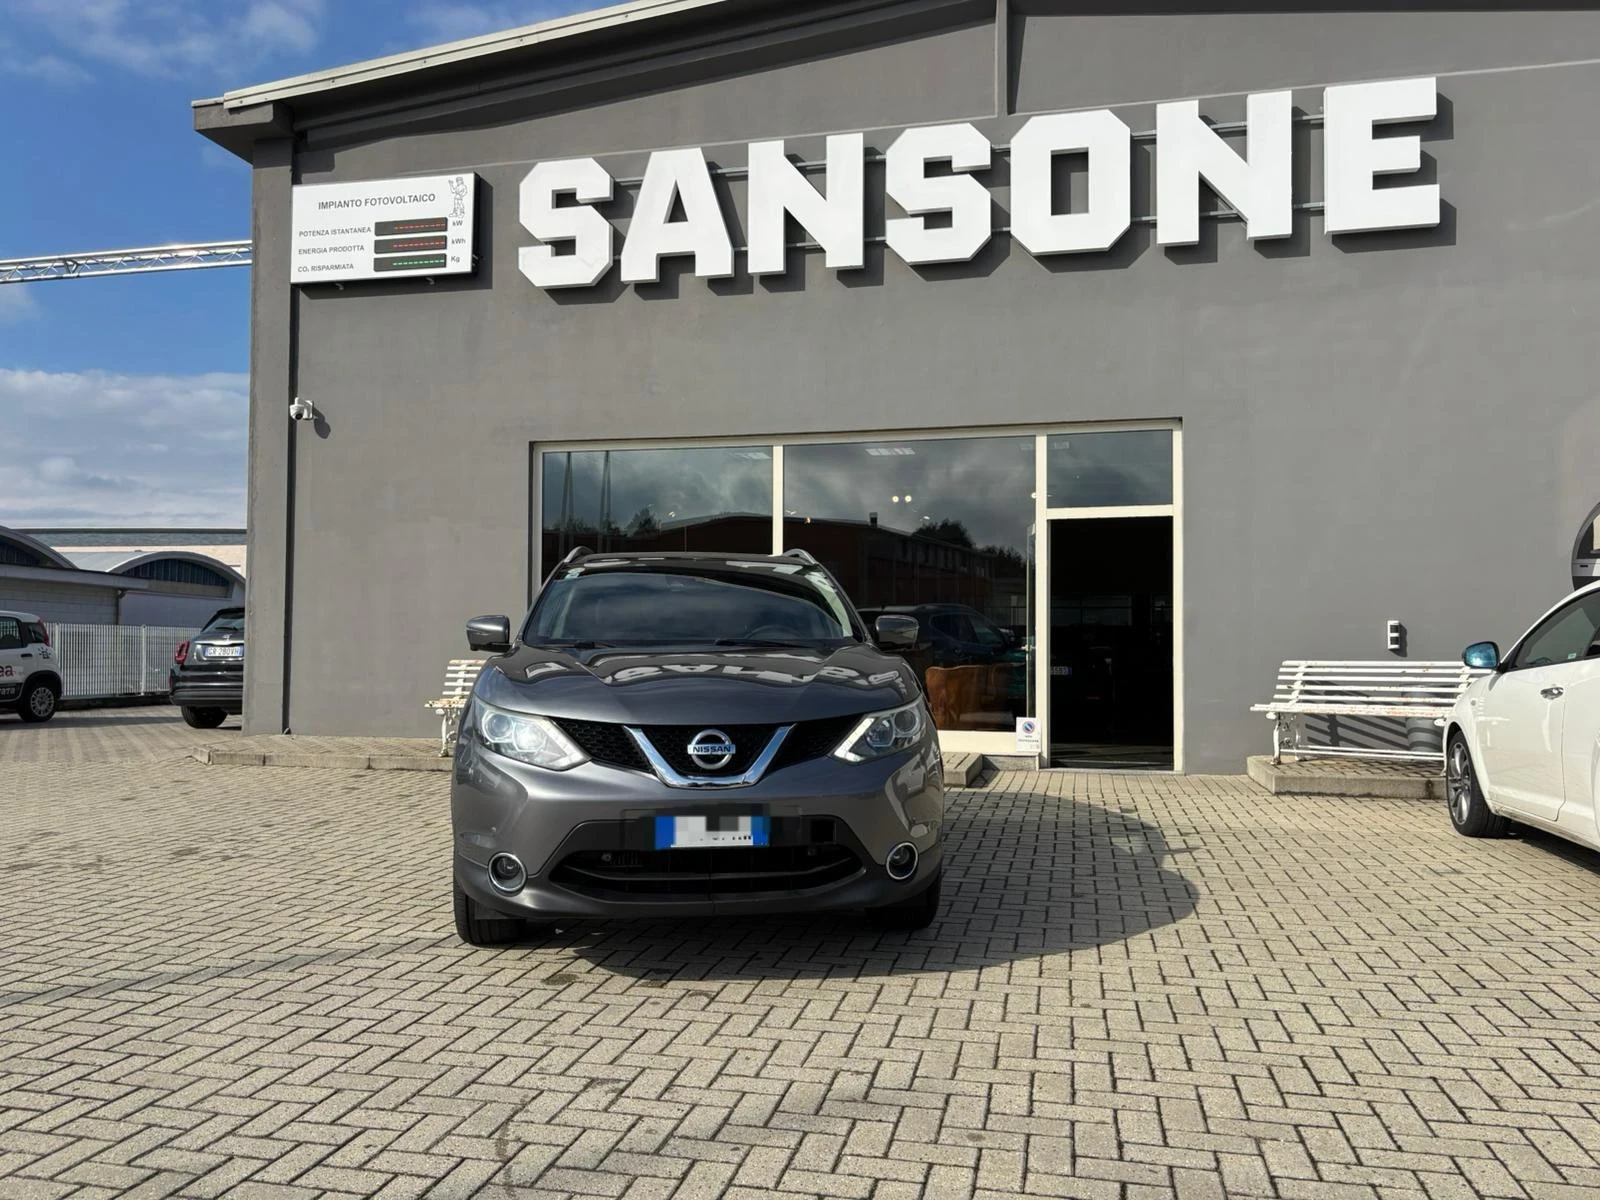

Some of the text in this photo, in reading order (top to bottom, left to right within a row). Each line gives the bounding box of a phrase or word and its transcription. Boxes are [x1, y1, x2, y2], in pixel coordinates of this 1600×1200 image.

[518, 76, 1441, 290] SANSONE
[318, 193, 436, 210] IMPIANTO FOTOVOLTAICO
[452, 219, 463, 227] kW
[298, 226, 372, 238] POTENZA ISTANTANEA
[451, 237, 466, 245] kWh
[298, 245, 365, 255] ENERGIA PRODOTTA
[450, 255, 461, 264] Kg
[310, 263, 354, 272] RISPARMIATA
[692, 745, 731, 753] NISSAN
